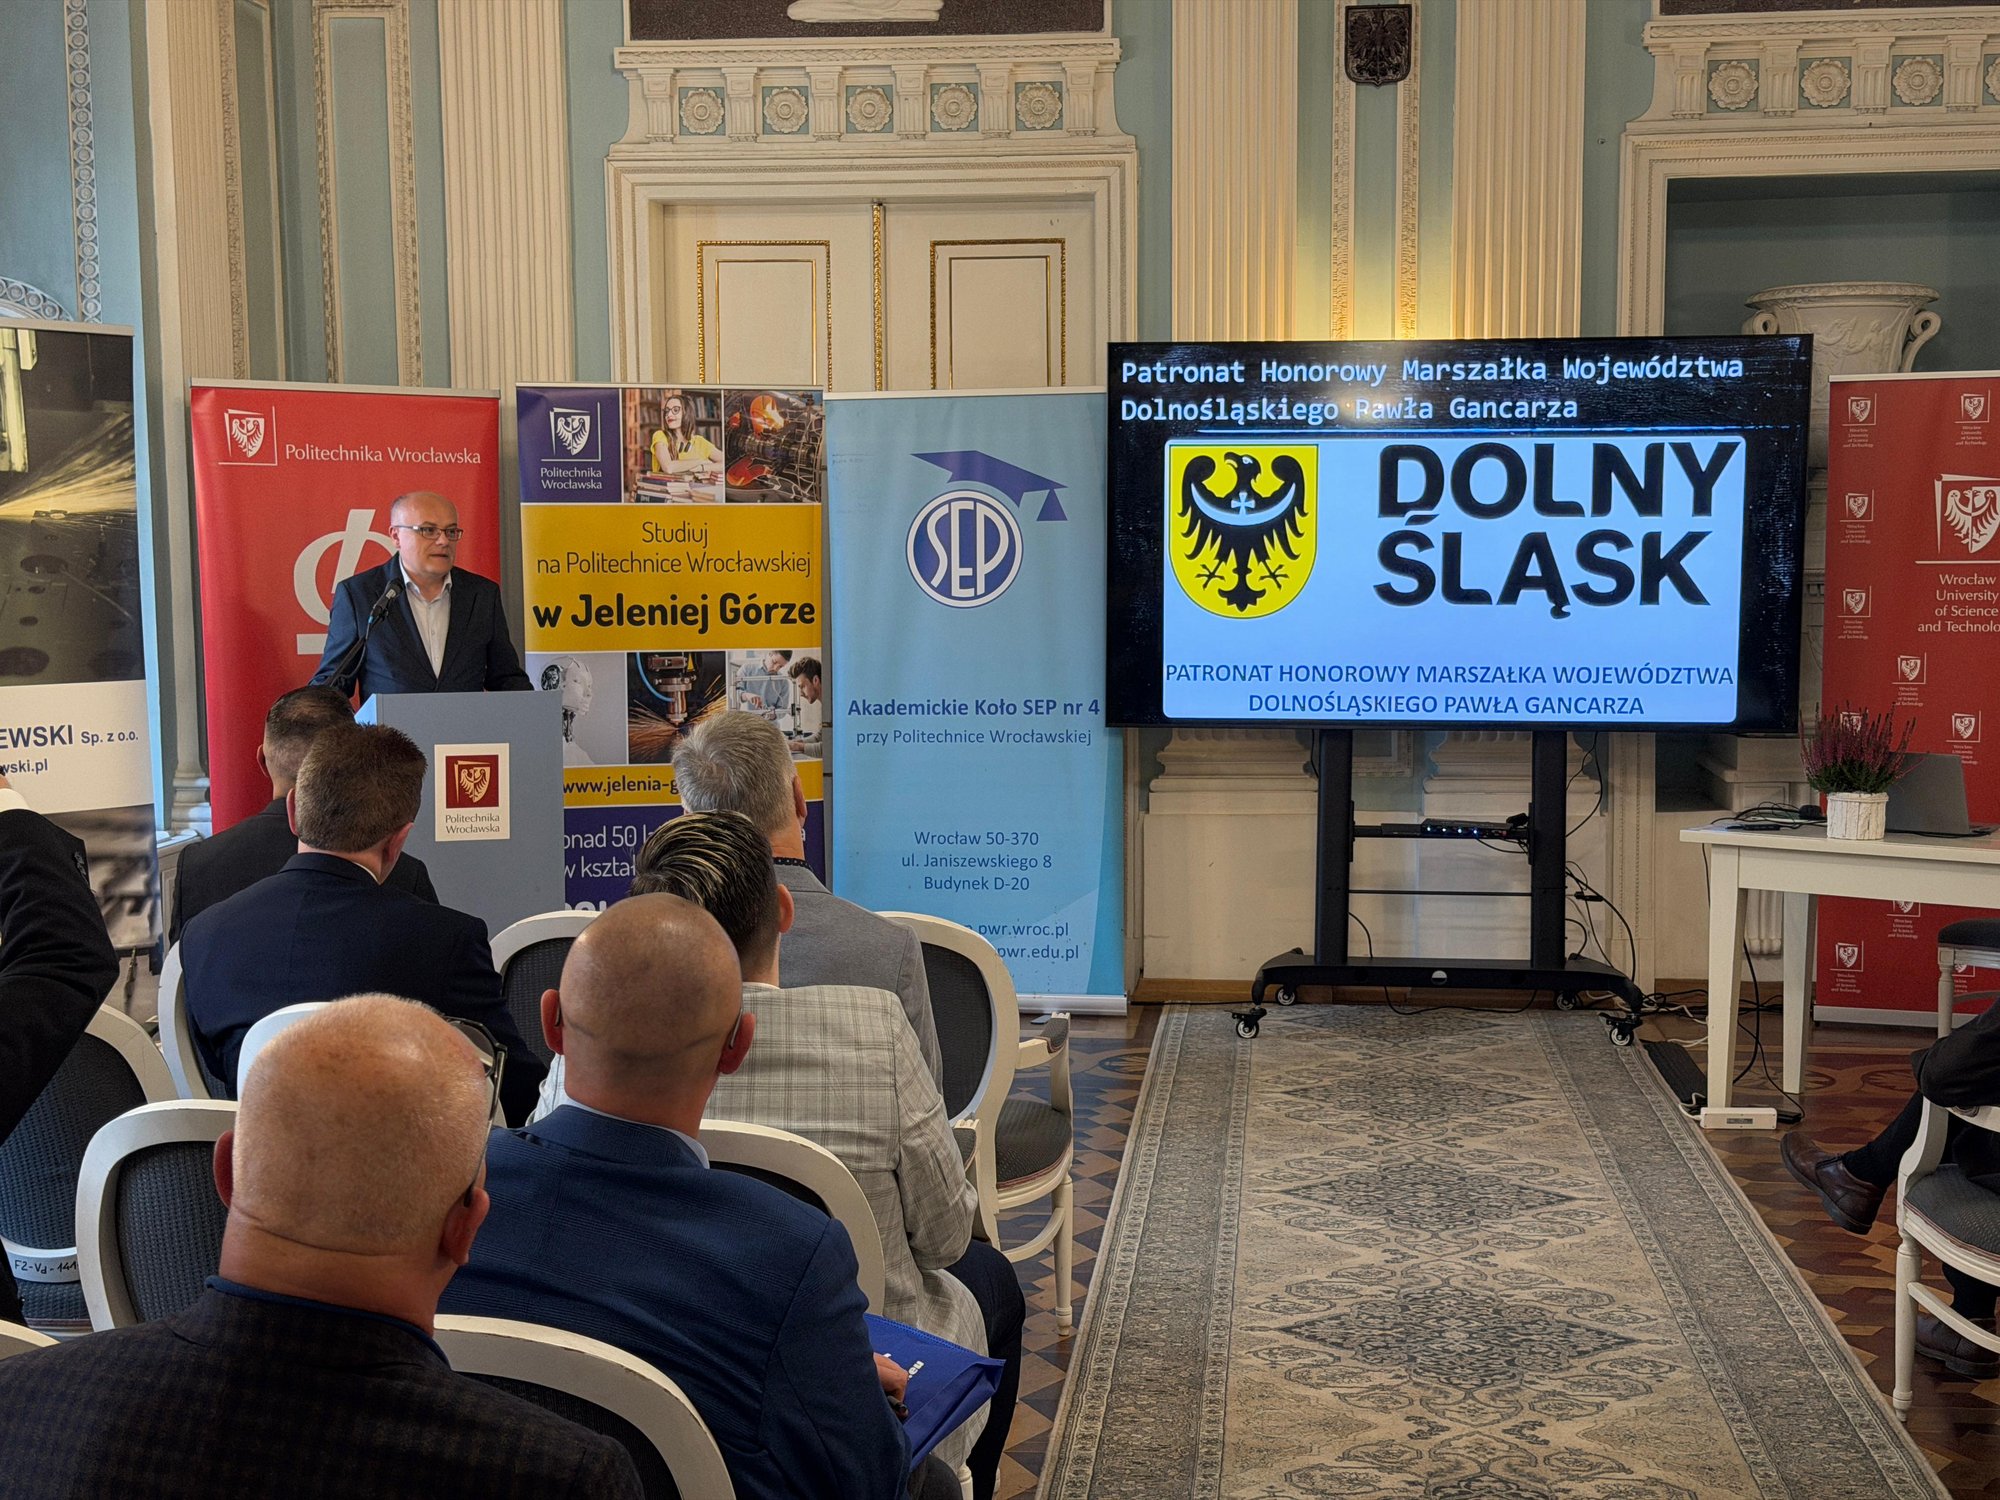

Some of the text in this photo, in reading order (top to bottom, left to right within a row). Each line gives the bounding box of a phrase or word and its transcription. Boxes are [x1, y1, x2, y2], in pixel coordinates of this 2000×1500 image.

[1122, 354, 1743, 387] Patronat Honorowy Marszałka Województwa
[1121, 397, 1578, 425] Dolnośląskiego Pawła Gancarza
[286, 443, 481, 464] Politechnika Wrocławska
[540, 466, 602, 478] Politechnika
[1378, 442, 1741, 519] DOLNY
[541, 479, 602, 490] Wrocławska
[641, 520, 708, 549] Studiuj
[927, 500, 1009, 597] SEP
[537, 550, 811, 578] na Politechnice Wrocławskiej
[1373, 514, 1713, 619] ŚLĄSK
[1939, 573, 1997, 585] Wrocław
[1936, 589, 1999, 604] University
[532, 592, 815, 635] w Jeleniej Górze
[1935, 604, 1999, 617] of Science
[1918, 620, 1941, 632] and
[1166, 663, 1734, 685] PATRONAT HONOROWY MARSZAŁKA WOJEWÓDZTWA
[848, 698, 1100, 716] Akademickie Koło SEP nr 4
[1249, 691, 1644, 716] DOLNOŚLĄSKIEGO PAWŁA GANCARZA
[81, 731, 103, 746] Sp.
[107, 732, 114, 742] z
[117, 731, 139, 741] o.o.
[857, 729, 1091, 747] przy Politechnice Wrocławskiej
[445, 813, 500, 823] Politechnika
[446, 823, 500, 834] Wrocławska
[612, 825, 637, 847] 50
[914, 831, 1039, 846] Wrocław 50-370
[901, 854, 1052, 871] ul. Janiszewskiego 8
[924, 876, 1030, 893] Budynek D-20
[966, 922, 1069, 939] pwr.wroc.pl
